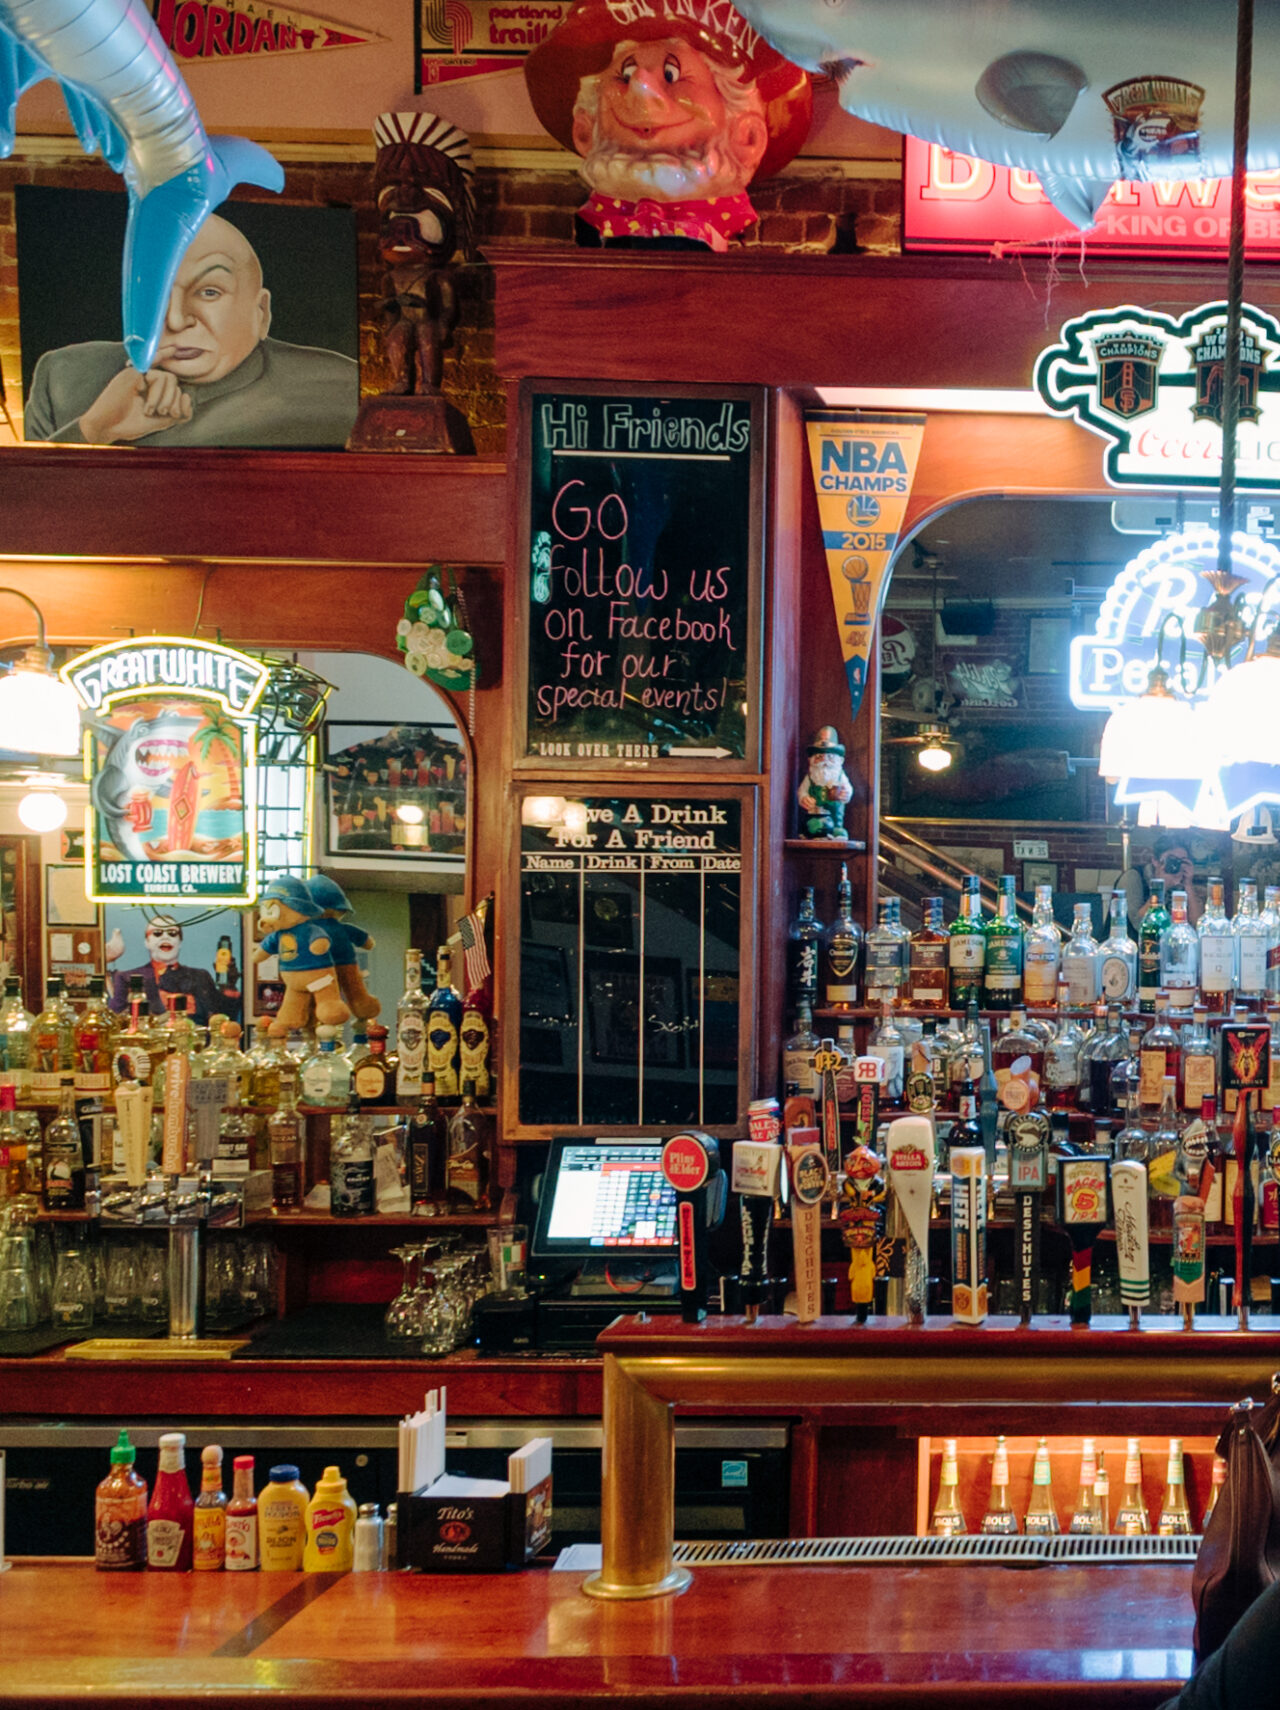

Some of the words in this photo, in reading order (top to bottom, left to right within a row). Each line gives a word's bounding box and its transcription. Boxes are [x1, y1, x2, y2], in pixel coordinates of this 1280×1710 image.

[489, 6, 562, 22] portland
[1106, 215, 1187, 237] KING
[1100, 347, 1159, 360] CHAMPIONS
[541, 403, 588, 449] Hi
[602, 402, 751, 452] Friends
[820, 440, 908, 475] NBA
[819, 475, 908, 493] CHAMPS
[841, 532, 887, 550] 2015
[690, 567, 731, 602] us
[544, 608, 593, 641] on
[608, 601, 737, 650] Facebook
[560, 641, 611, 678] for
[622, 654, 678, 678] our
[73, 649, 157, 709] GREAT
[157, 648, 262, 709] WHITE
[537, 676, 627, 723] special
[540, 743, 572, 757] LOOK
[577, 744, 611, 757] OVER
[617, 744, 659, 759] THERE
[621, 804, 643, 824] A
[651, 804, 728, 825] Drink
[554, 830, 598, 849] For
[604, 829, 627, 849] A
[634, 830, 717, 850] Friend
[526, 855, 575, 869] Name
[587, 855, 638, 869] Drink
[650, 856, 695, 870] From
[703, 856, 742, 870] Date
[100, 863, 133, 884] LOST
[136, 863, 179, 884] COAST
[181, 864, 243, 884] BREWERY
[143, 884, 180, 894] EUREKA
[669, 1152, 695, 1164] Pliny
[1017, 1165, 1040, 1182] IPA
[1065, 1176, 1105, 1196] RACER
[1075, 1193, 1096, 1210] 5
[1071, 1212, 1099, 1221] IPA
[1021, 1195, 1033, 1303] DESCHUTES
[803, 1211, 816, 1316] DESCHUTES
[436, 1506, 475, 1521] Tito's
[432, 1542, 480, 1554] Handmade
